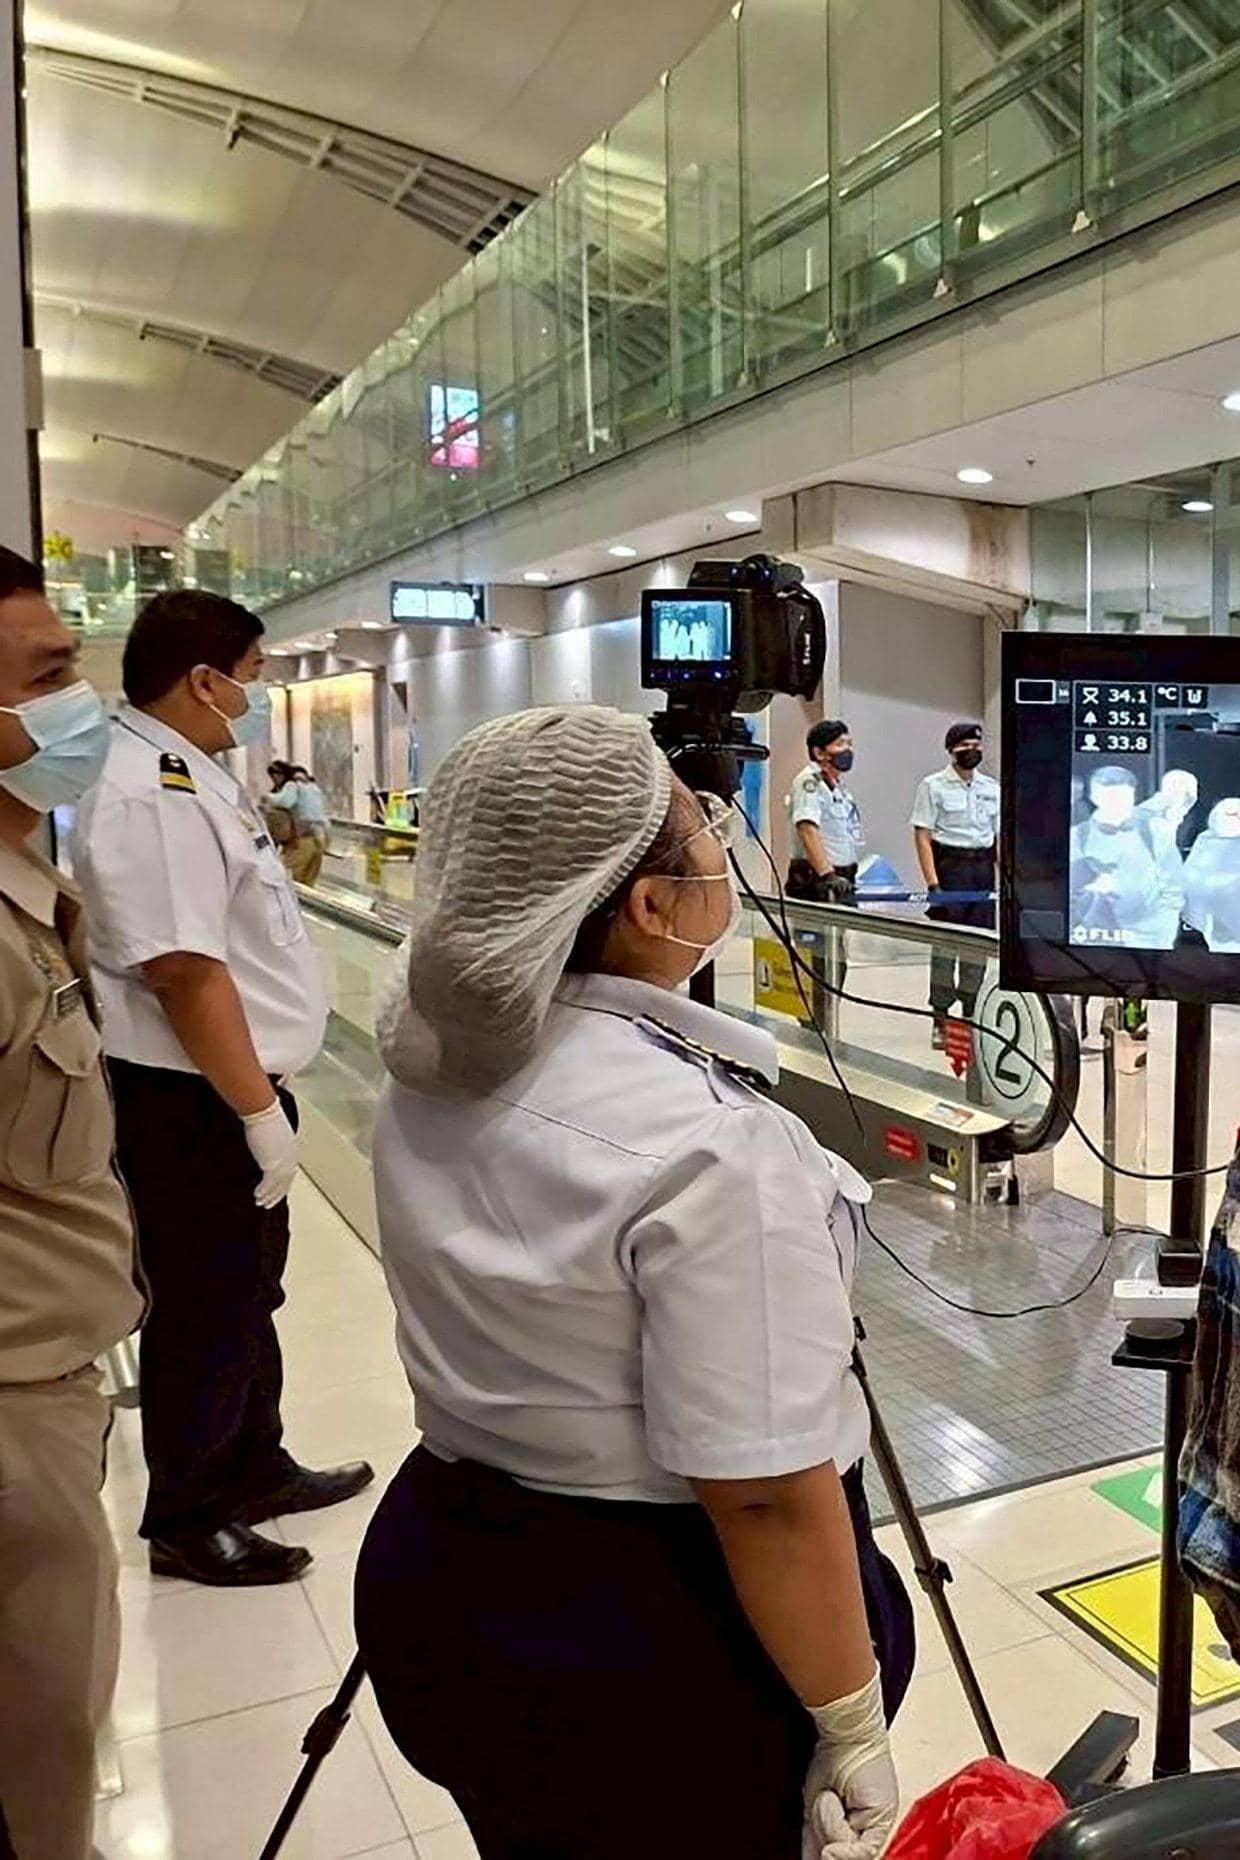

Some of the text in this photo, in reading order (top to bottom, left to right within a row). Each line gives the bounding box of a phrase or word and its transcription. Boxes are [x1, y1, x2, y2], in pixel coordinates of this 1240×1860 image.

[1108, 688, 1147, 704] 34.1
[1107, 711, 1147, 726] 35.1
[1107, 735, 1148, 751] 33.8
[995, 1001, 1021, 1085] 2
